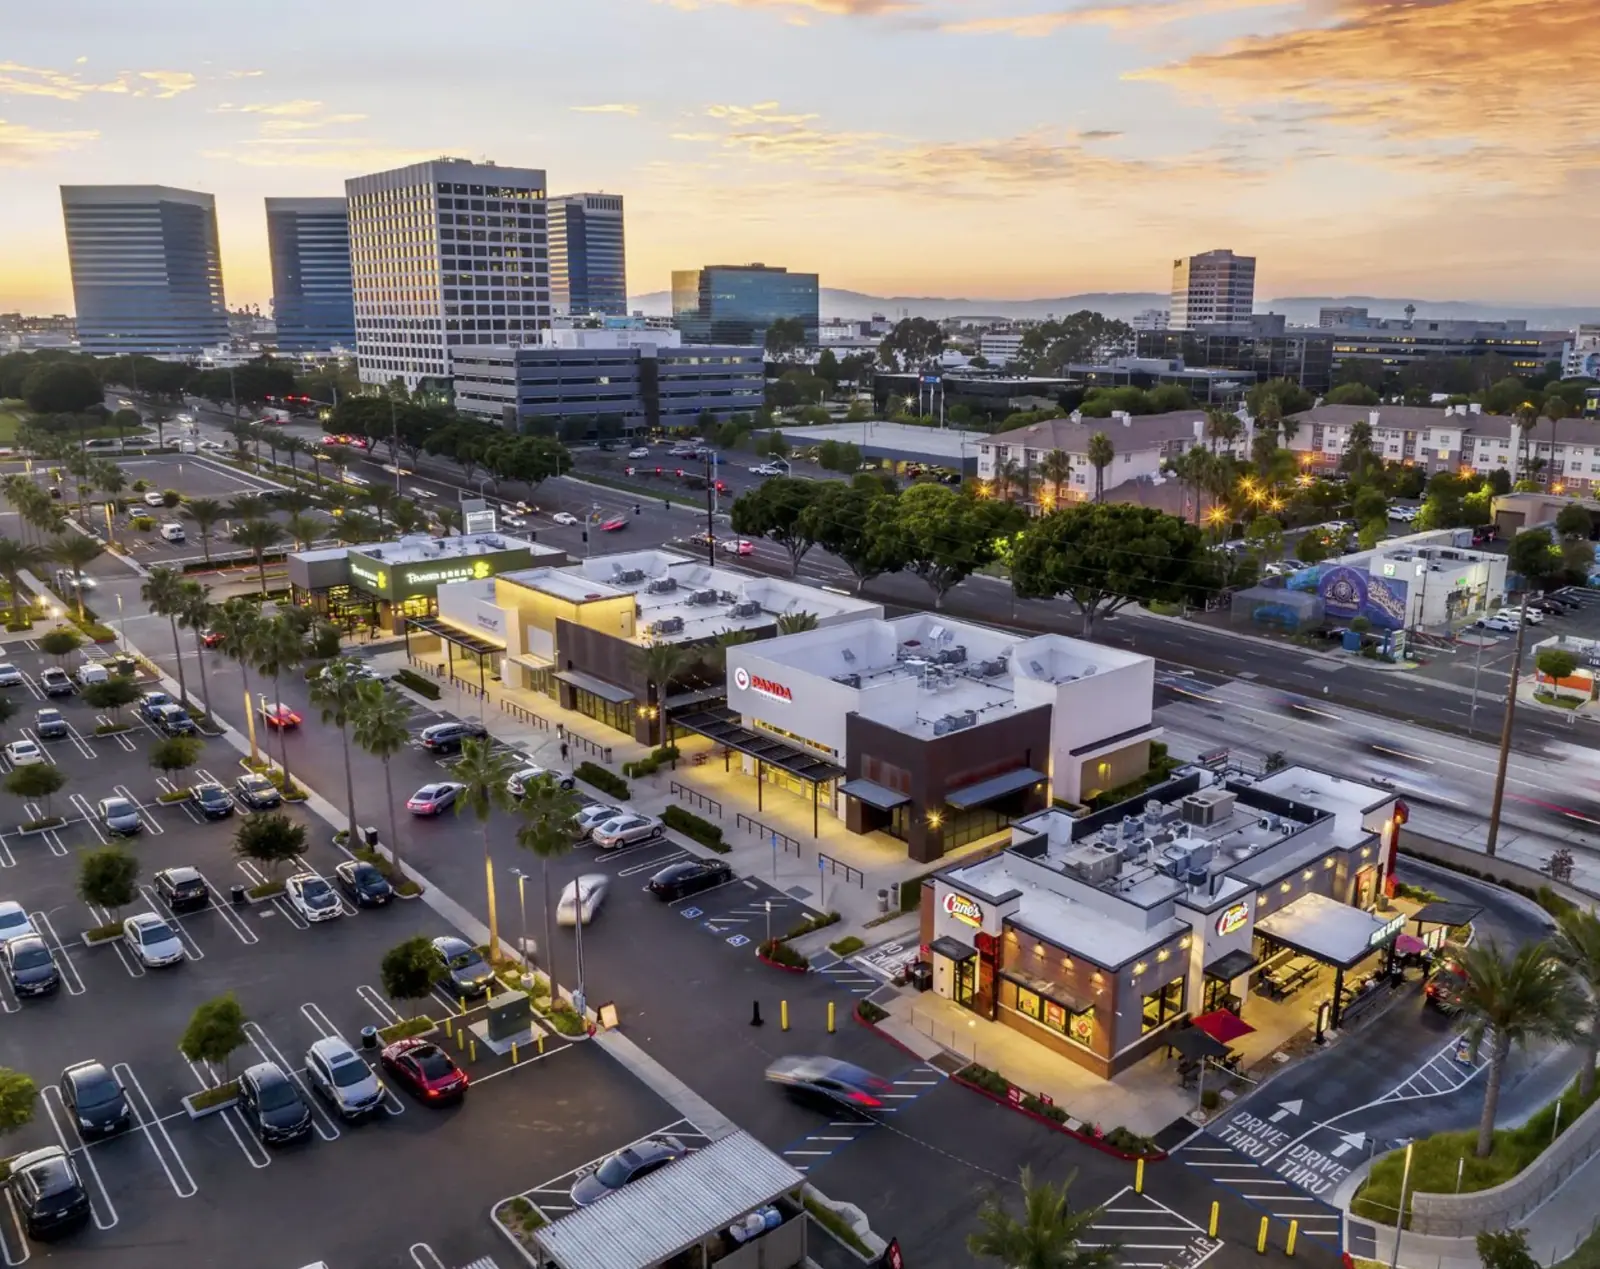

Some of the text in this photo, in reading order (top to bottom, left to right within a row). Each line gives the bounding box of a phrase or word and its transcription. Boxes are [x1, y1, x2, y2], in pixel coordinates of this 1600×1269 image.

[441, 567, 474, 579] BREAD
[751, 674, 793, 701] PANDA
[943, 892, 981, 918] Cane's
[1218, 902, 1249, 937] Cane's
[1218, 1124, 1271, 1158] THRU
[1231, 1111, 1291, 1147] DRIVE
[1276, 1158, 1333, 1195] THRU
[1288, 1143, 1352, 1182] DRIVE
